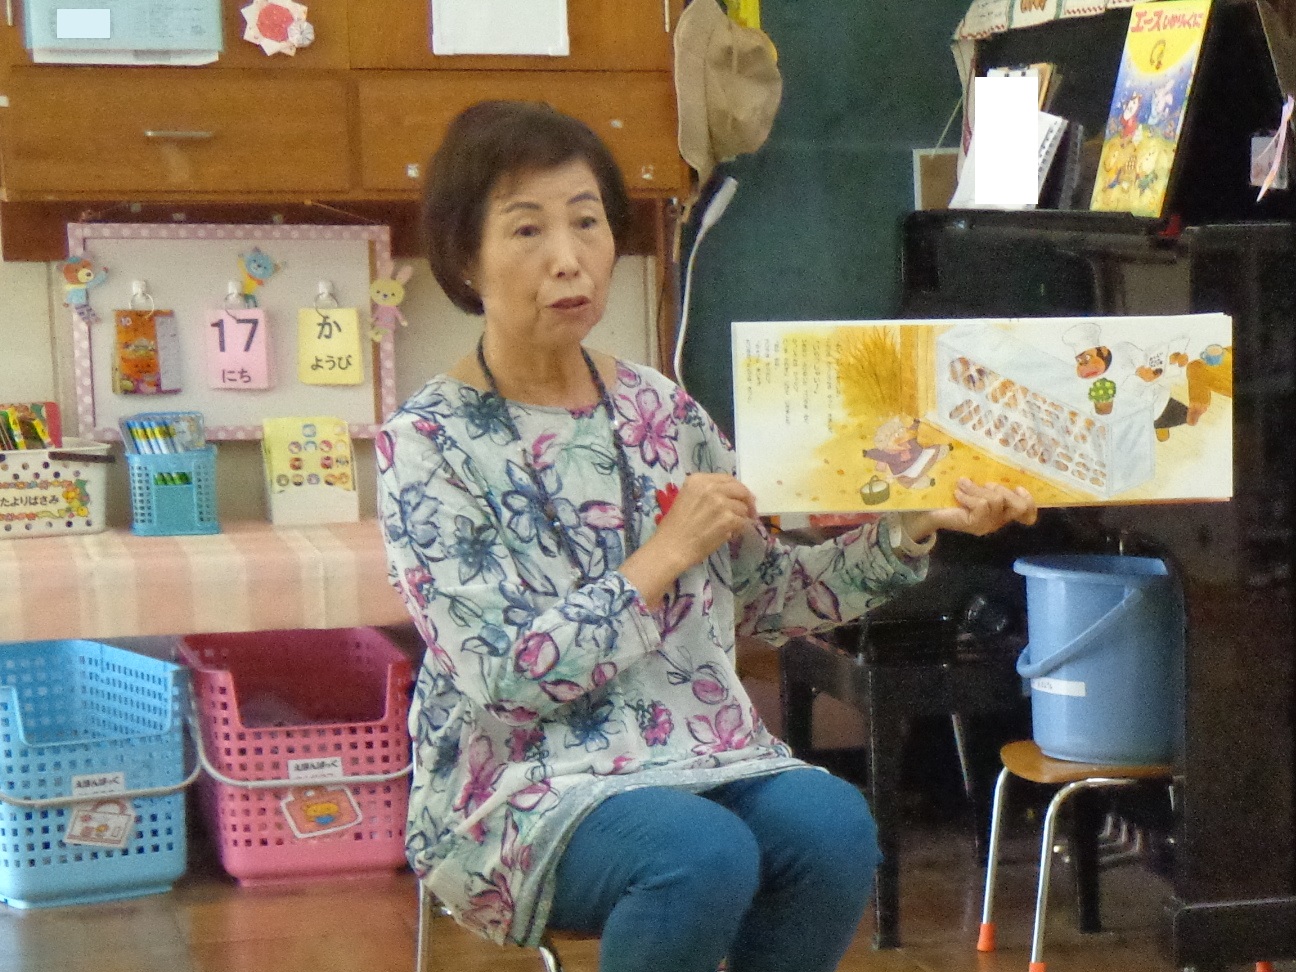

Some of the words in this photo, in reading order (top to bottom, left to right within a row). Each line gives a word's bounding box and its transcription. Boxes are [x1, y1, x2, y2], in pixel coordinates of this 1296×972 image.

[211, 318, 259, 353] 17
[316, 316, 342, 340] か
[310, 354, 353, 371] ようび
[222, 367, 252, 384] にち
